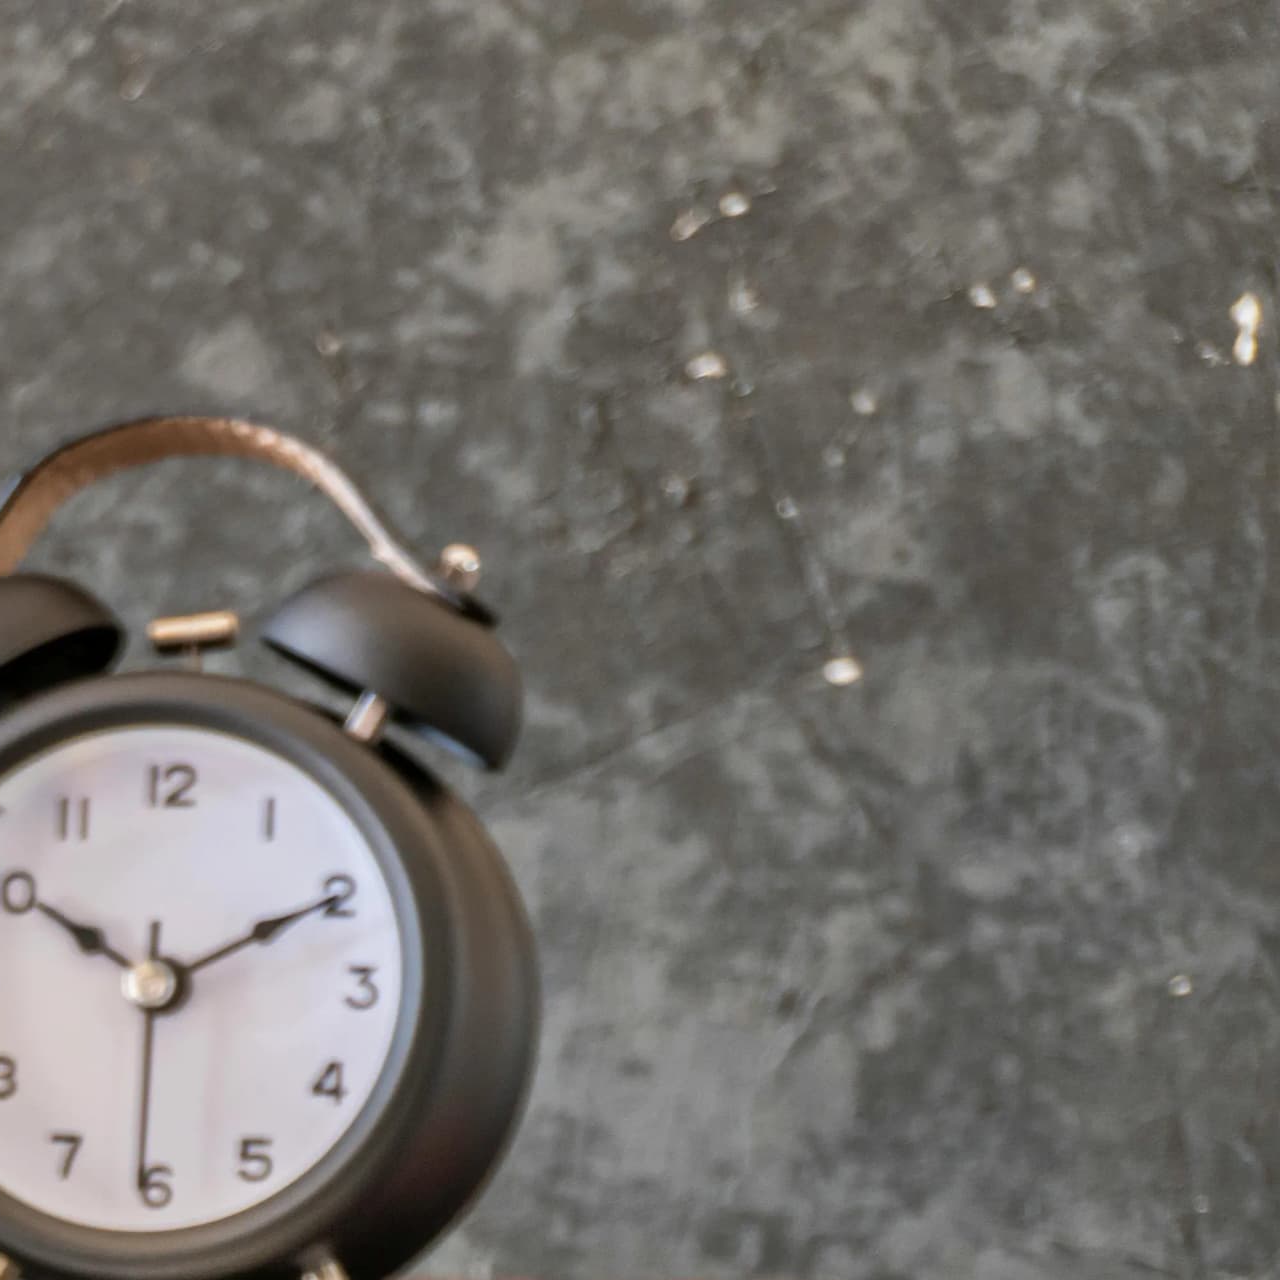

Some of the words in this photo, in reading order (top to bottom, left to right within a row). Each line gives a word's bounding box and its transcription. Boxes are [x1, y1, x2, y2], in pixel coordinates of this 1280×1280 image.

[149, 764, 197, 808] 12
[57, 797, 90, 841] 11
[263, 797, 276, 841] 1
[322, 875, 356, 918] 2
[346, 966, 379, 1011] 3
[312, 1062, 345, 1104] 4
[50, 1134, 83, 1179] 7
[239, 1138, 273, 1182] 5
[139, 1164, 172, 1209] 6
